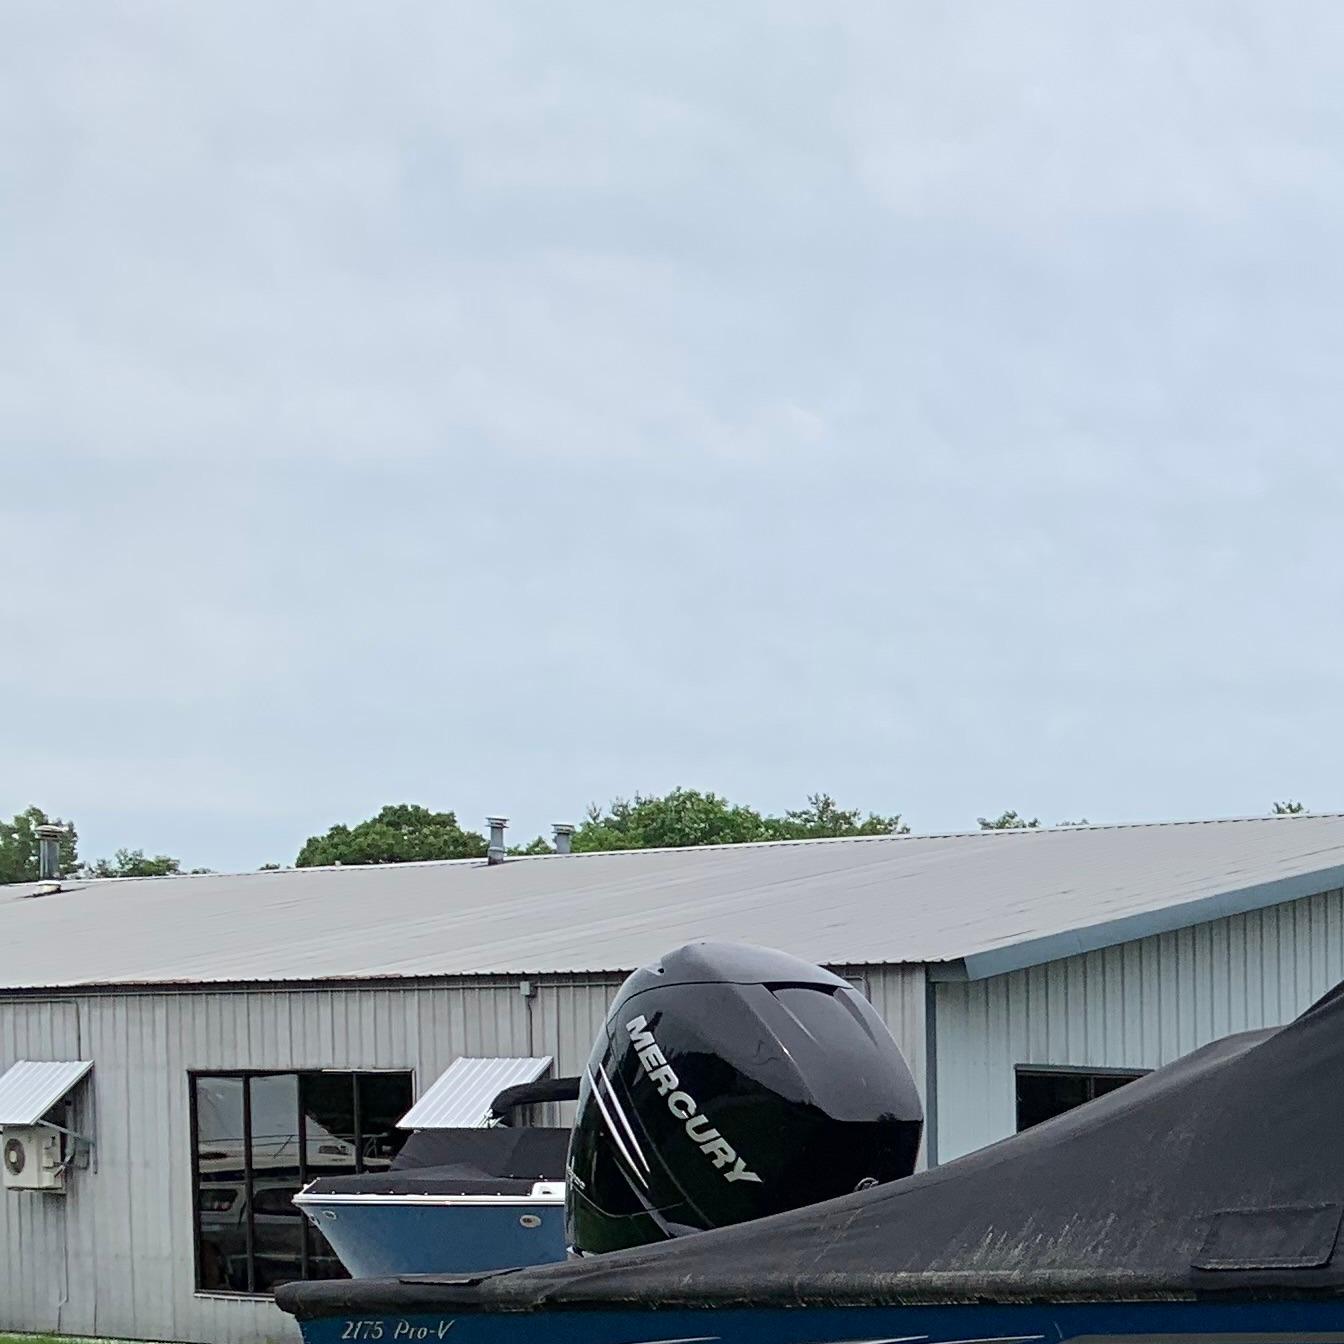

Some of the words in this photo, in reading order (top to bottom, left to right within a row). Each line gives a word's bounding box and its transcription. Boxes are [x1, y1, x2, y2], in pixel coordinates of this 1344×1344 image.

[626, 1015, 763, 1183] MERCURY
[341, 1320, 384, 1340] 2175
[394, 1319, 455, 1340] Pro-V
